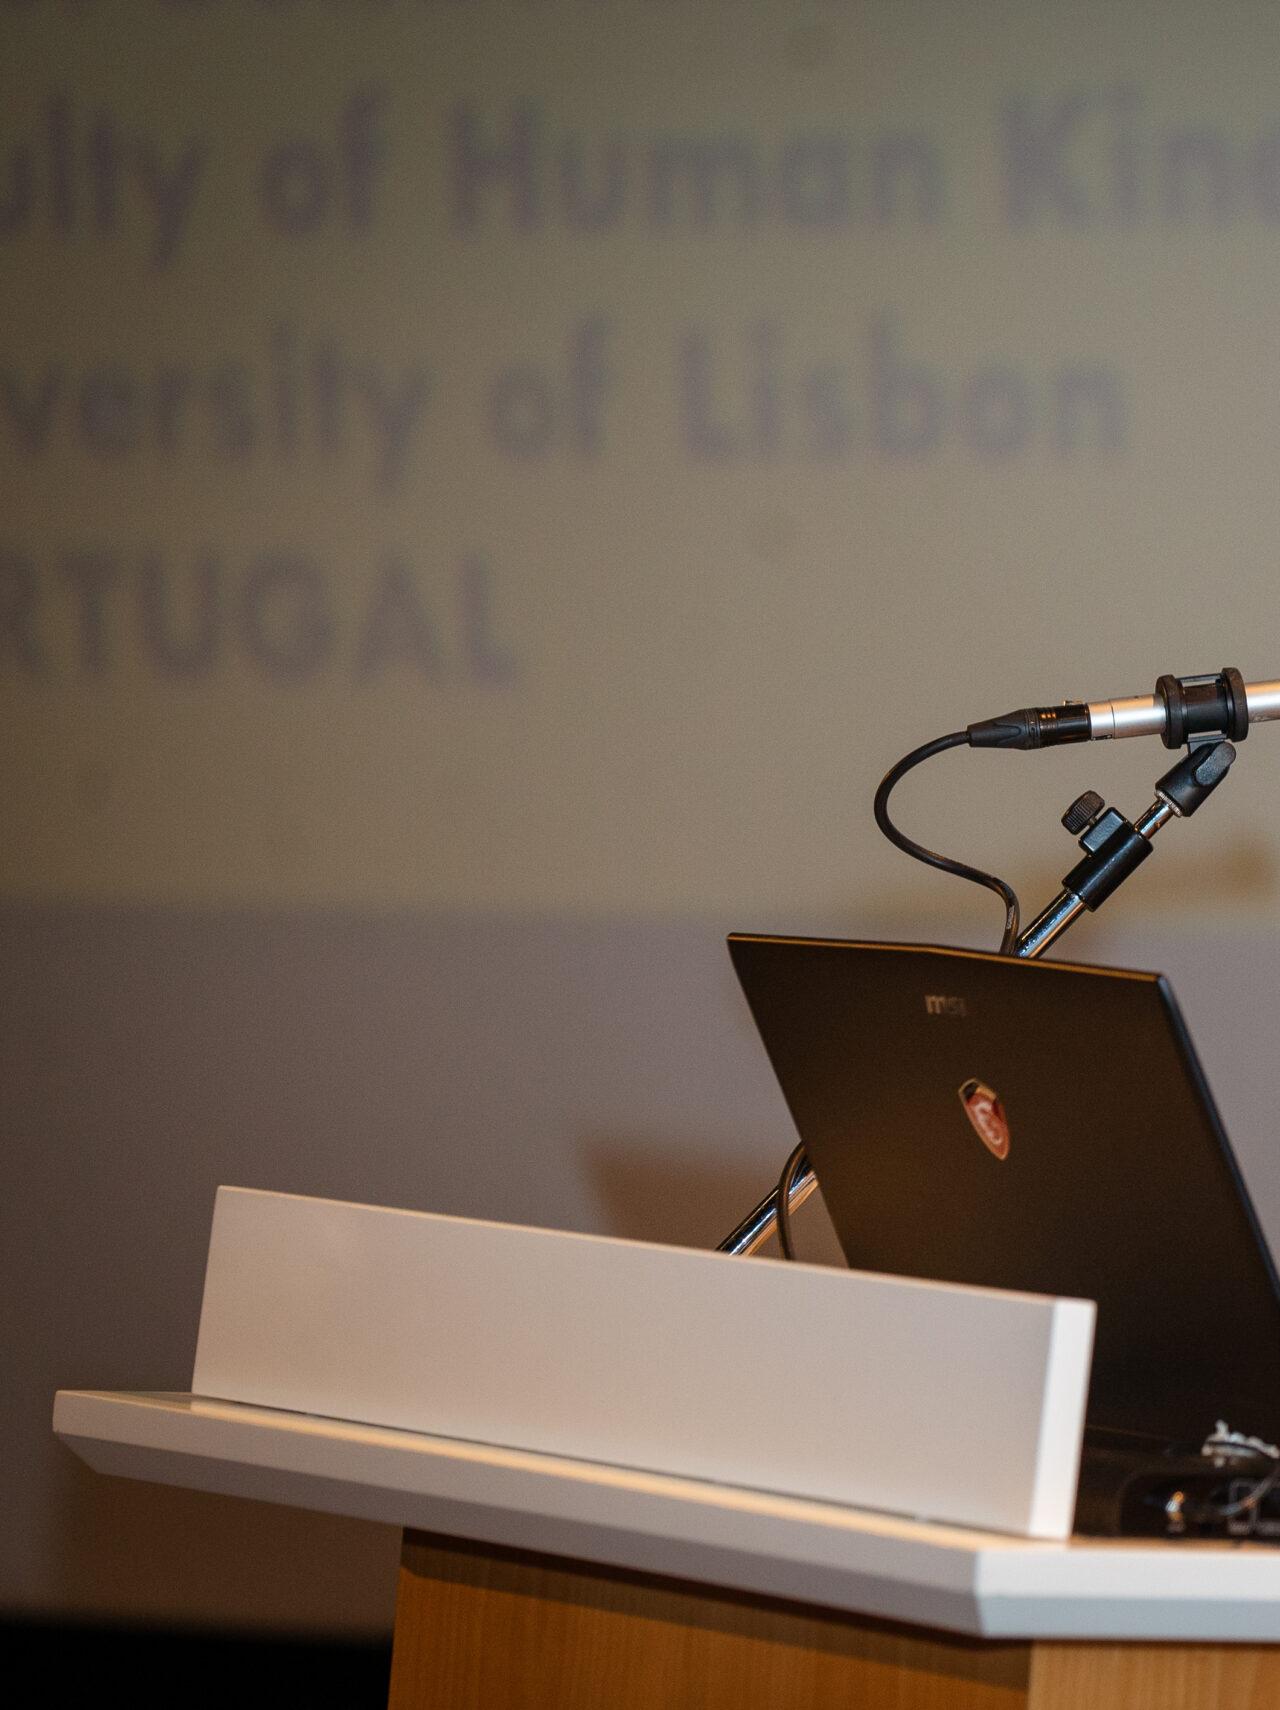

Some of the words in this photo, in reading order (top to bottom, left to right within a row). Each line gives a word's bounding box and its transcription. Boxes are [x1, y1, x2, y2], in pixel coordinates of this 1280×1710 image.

[259, 76, 390, 238] of
[445, 94, 947, 236] Human
[486, 313, 616, 463] of
[679, 310, 1131, 465] Lisbon
